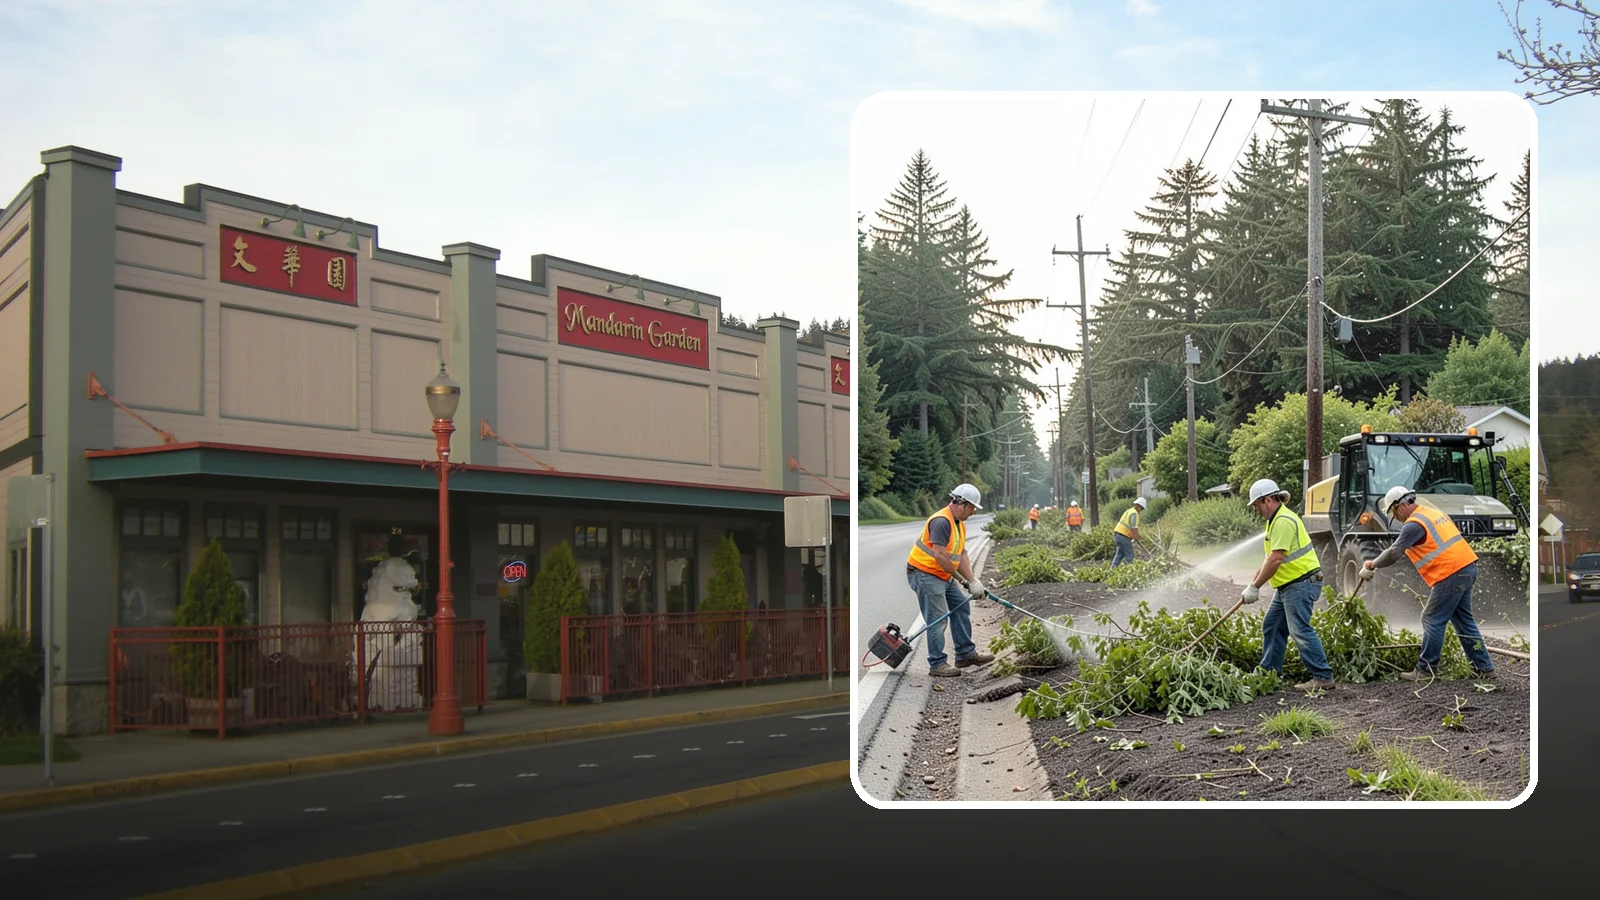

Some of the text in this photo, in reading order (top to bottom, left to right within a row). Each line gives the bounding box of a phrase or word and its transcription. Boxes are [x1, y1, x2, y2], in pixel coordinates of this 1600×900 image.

[231, 235, 347, 291] 文華園
[564, 302, 701, 352] Mandarin Garden
[503, 565, 527, 578] OPEN
